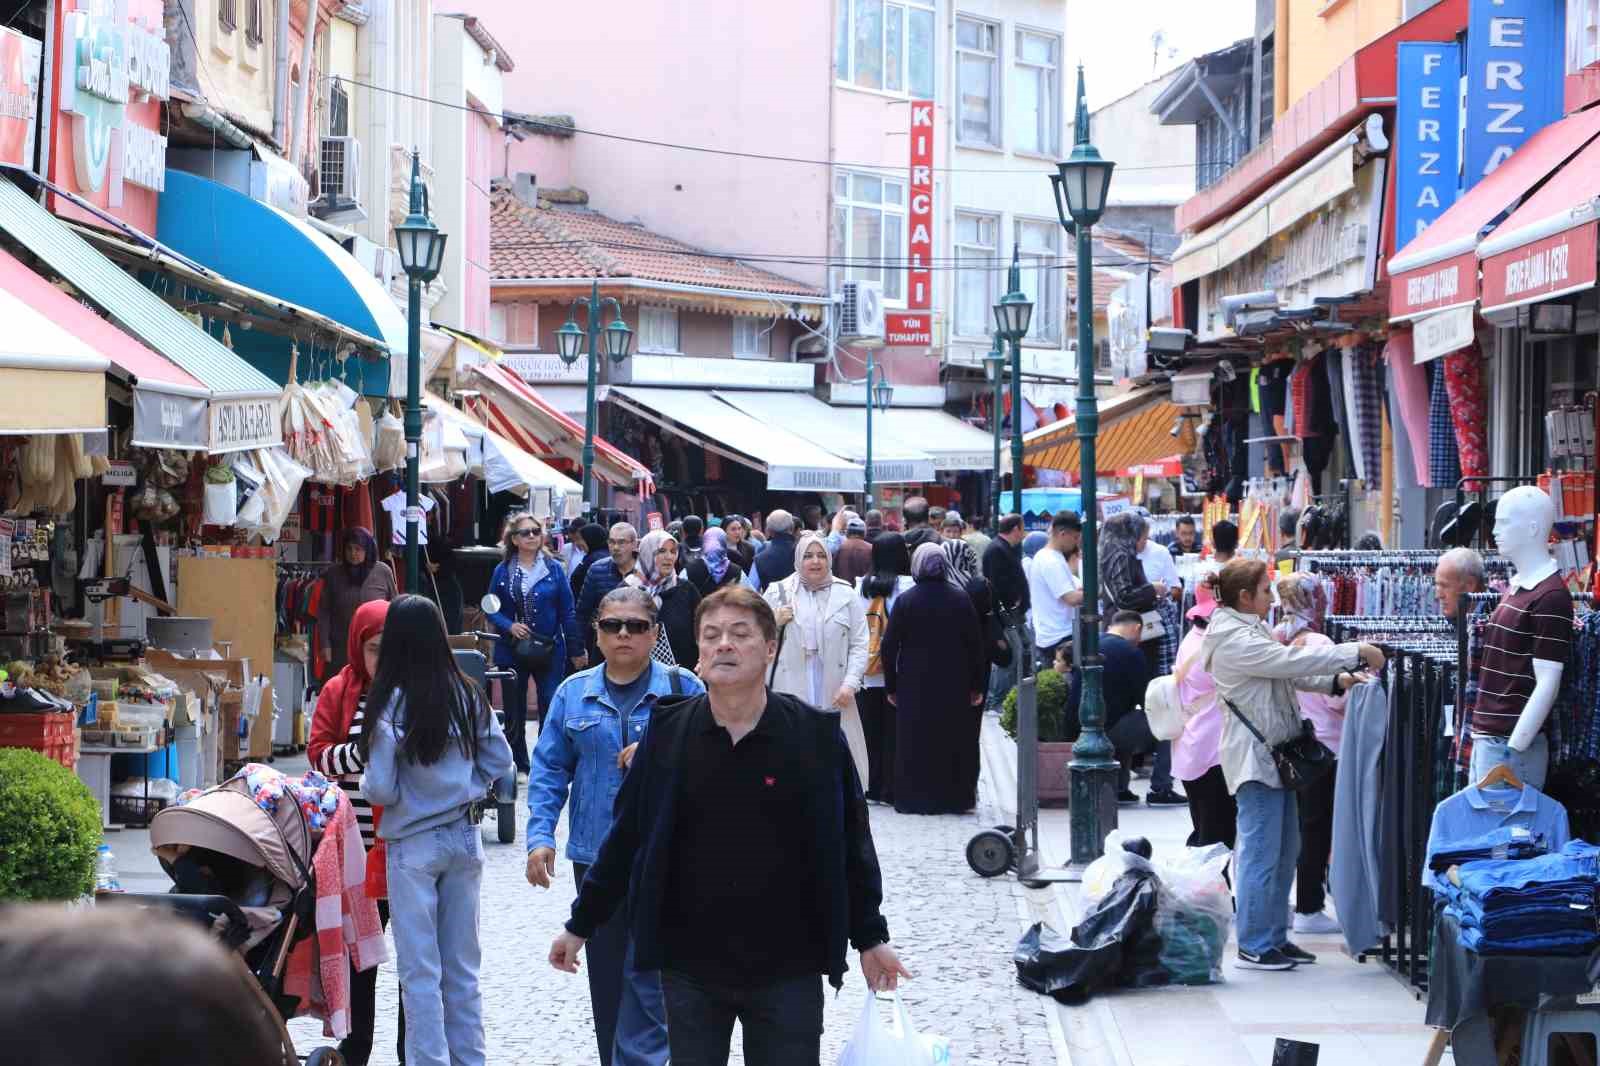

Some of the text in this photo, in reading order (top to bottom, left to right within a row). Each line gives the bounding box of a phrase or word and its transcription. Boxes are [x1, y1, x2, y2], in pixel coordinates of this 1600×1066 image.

[1482, 0, 1526, 176] ERZA
[912, 106, 932, 302] KIRCALI
[888, 332, 930, 343] TUHAFİYE
[902, 318, 921, 329] YÜN
